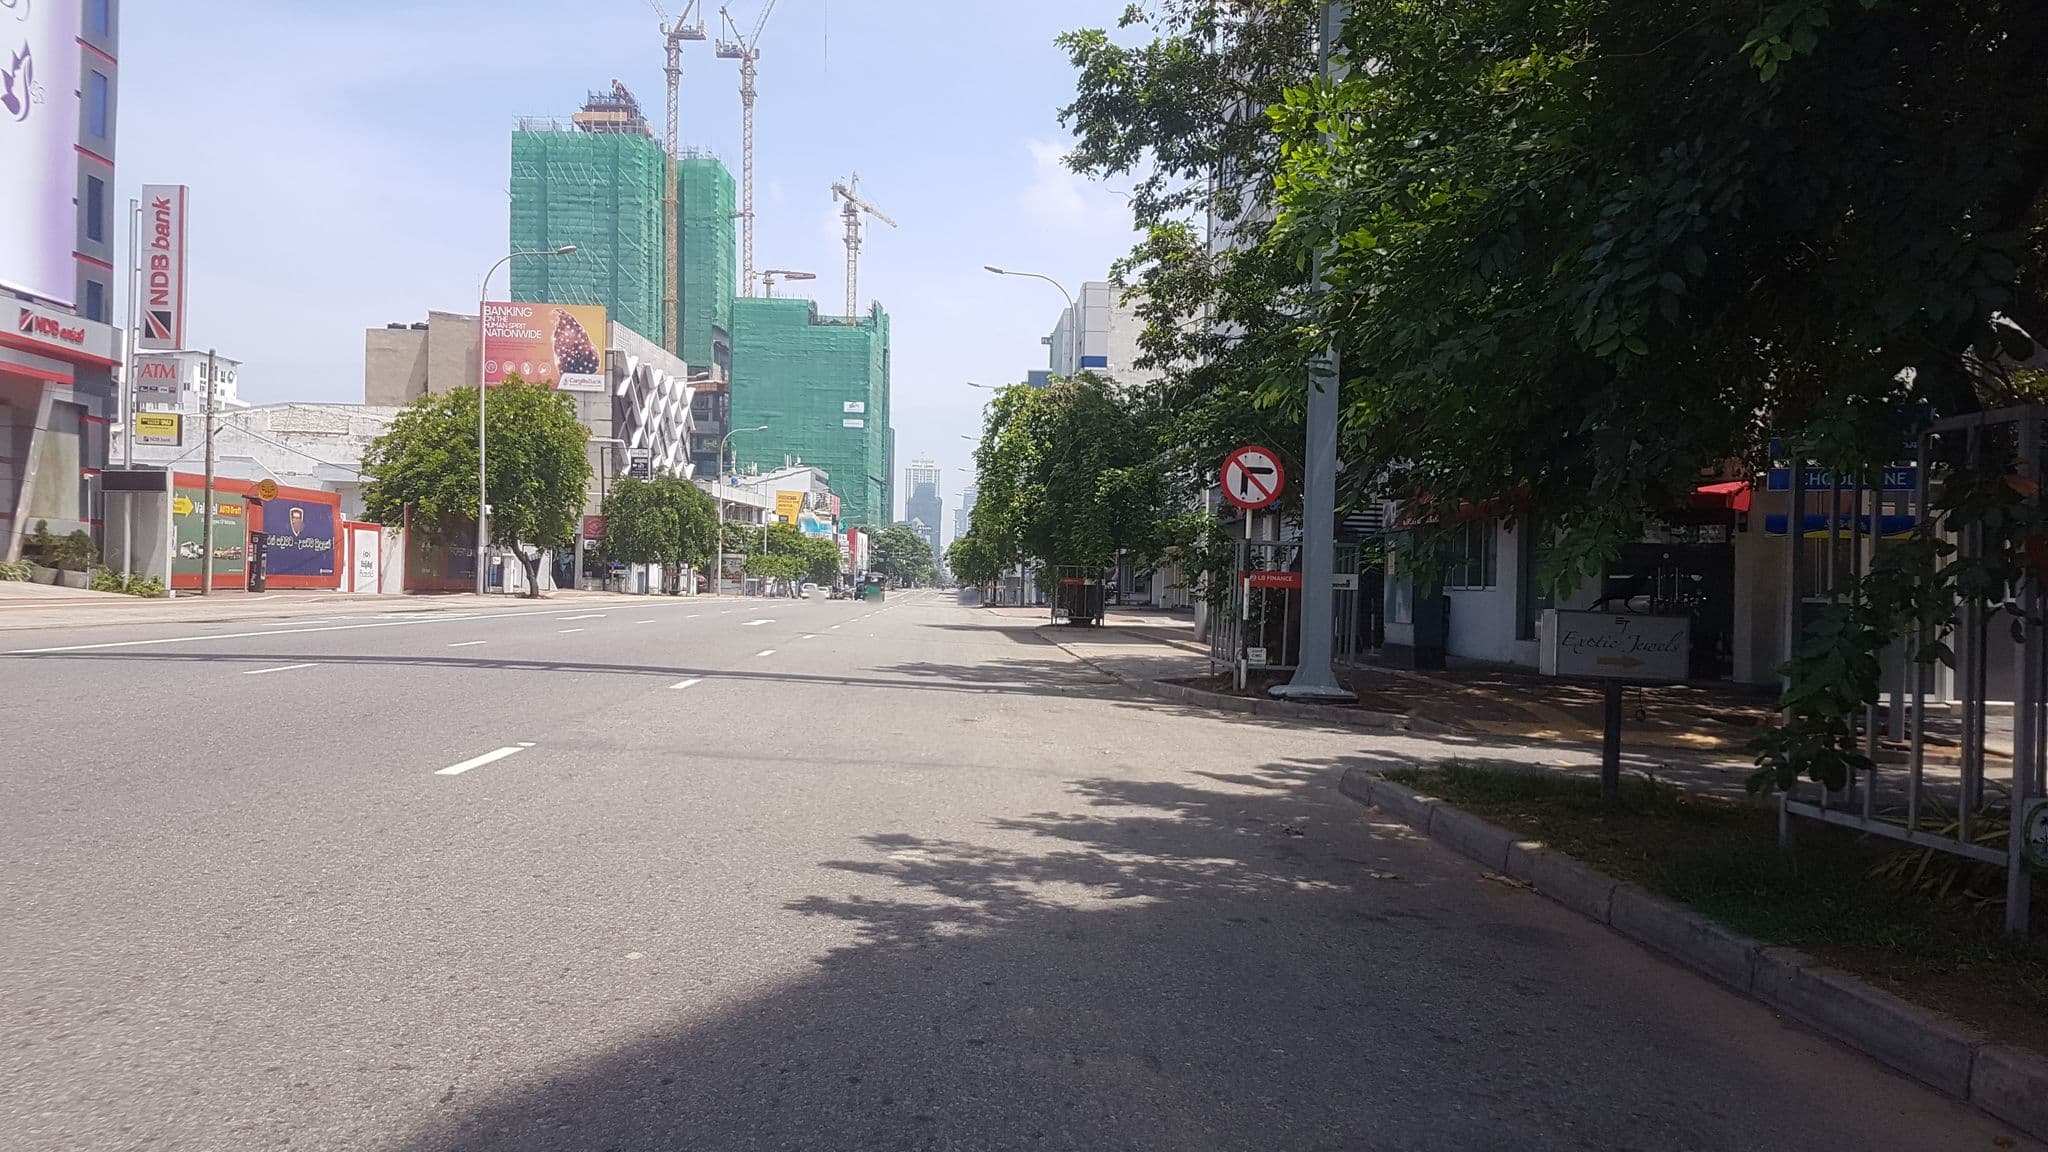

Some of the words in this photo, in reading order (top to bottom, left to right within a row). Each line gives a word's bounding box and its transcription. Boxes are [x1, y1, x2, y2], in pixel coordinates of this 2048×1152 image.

[151, 196, 170, 250] bank
[150, 254, 169, 305] NDB
[485, 305, 533, 317] BANKING
[509, 322, 526, 330] SPIRIT
[485, 329, 542, 339] NATIONWIDE
[141, 363, 176, 378] ATM
[1561, 631, 1618, 655] Exotic
[1620, 631, 1684, 653] Jewels
